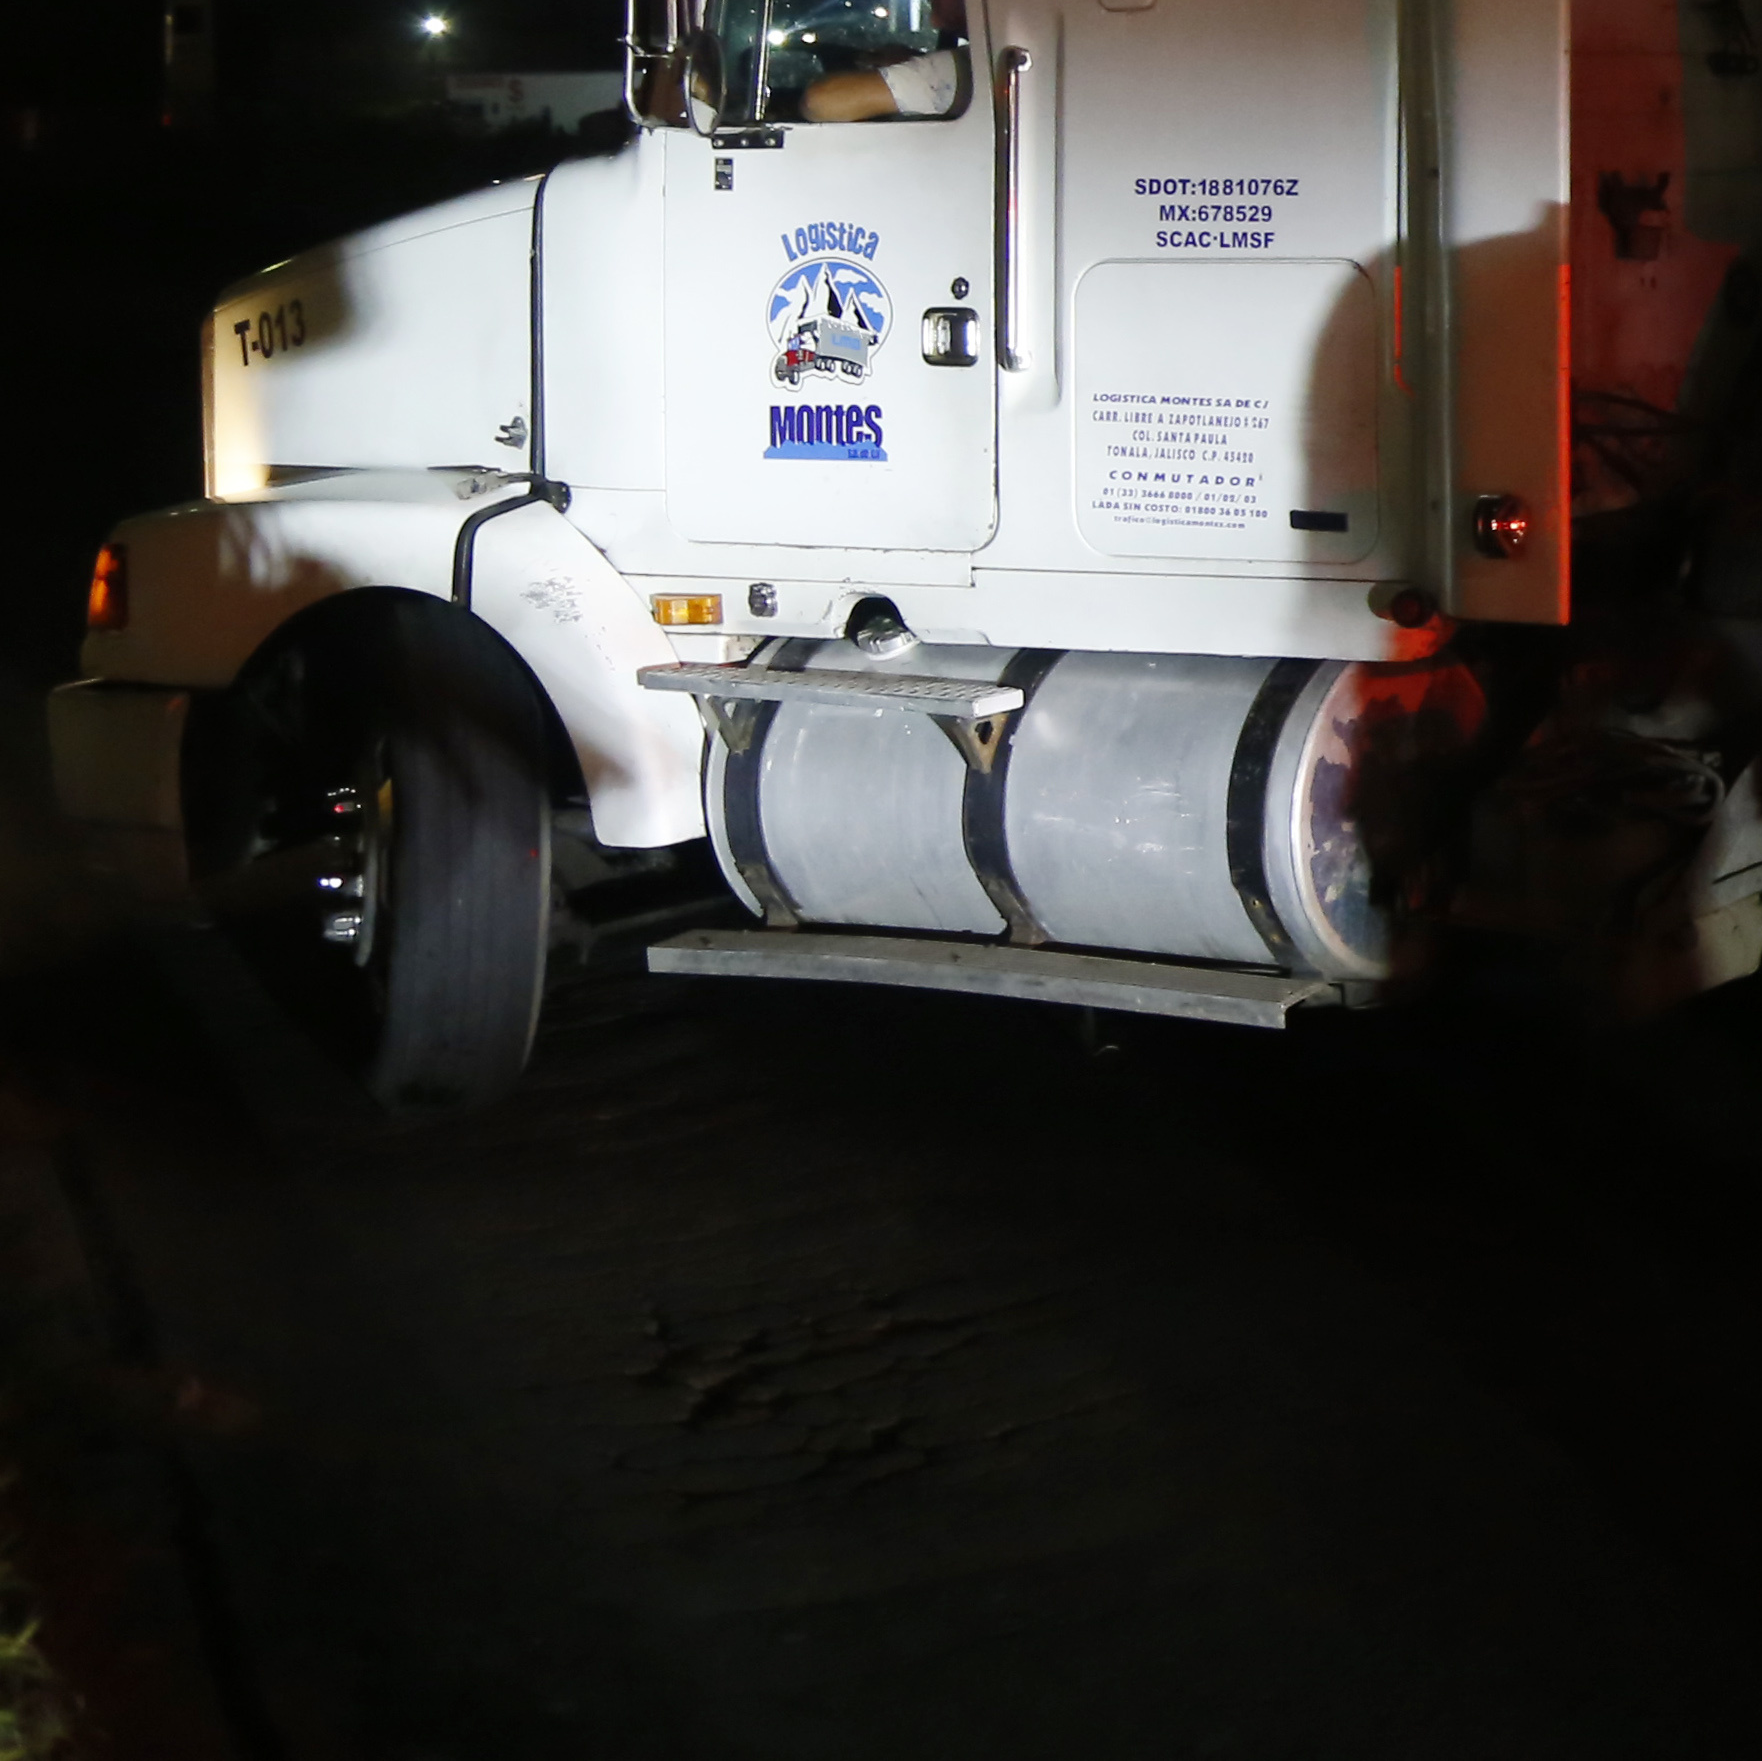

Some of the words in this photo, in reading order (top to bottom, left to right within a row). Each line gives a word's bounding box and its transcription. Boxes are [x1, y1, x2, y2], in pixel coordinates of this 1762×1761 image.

[1158, 204, 1273, 223] MX:678529
[234, 299, 307, 367] T-013
[1092, 393, 1157, 405] LOGISTICA
[1160, 396, 1212, 407] MONTES
[1235, 399, 1251, 408] DE
[1124, 411, 1153, 423] LIBRE
[1157, 413, 1164, 424] A
[1168, 413, 1241, 428] ZAPOTLANEJO
[1157, 431, 1191, 443] SANTA
[1194, 432, 1227, 445] PAULA
[1154, 447, 1196, 460] JALISCO
[1092, 500, 1120, 510] LADA
[1123, 501, 1141, 511] SIN
